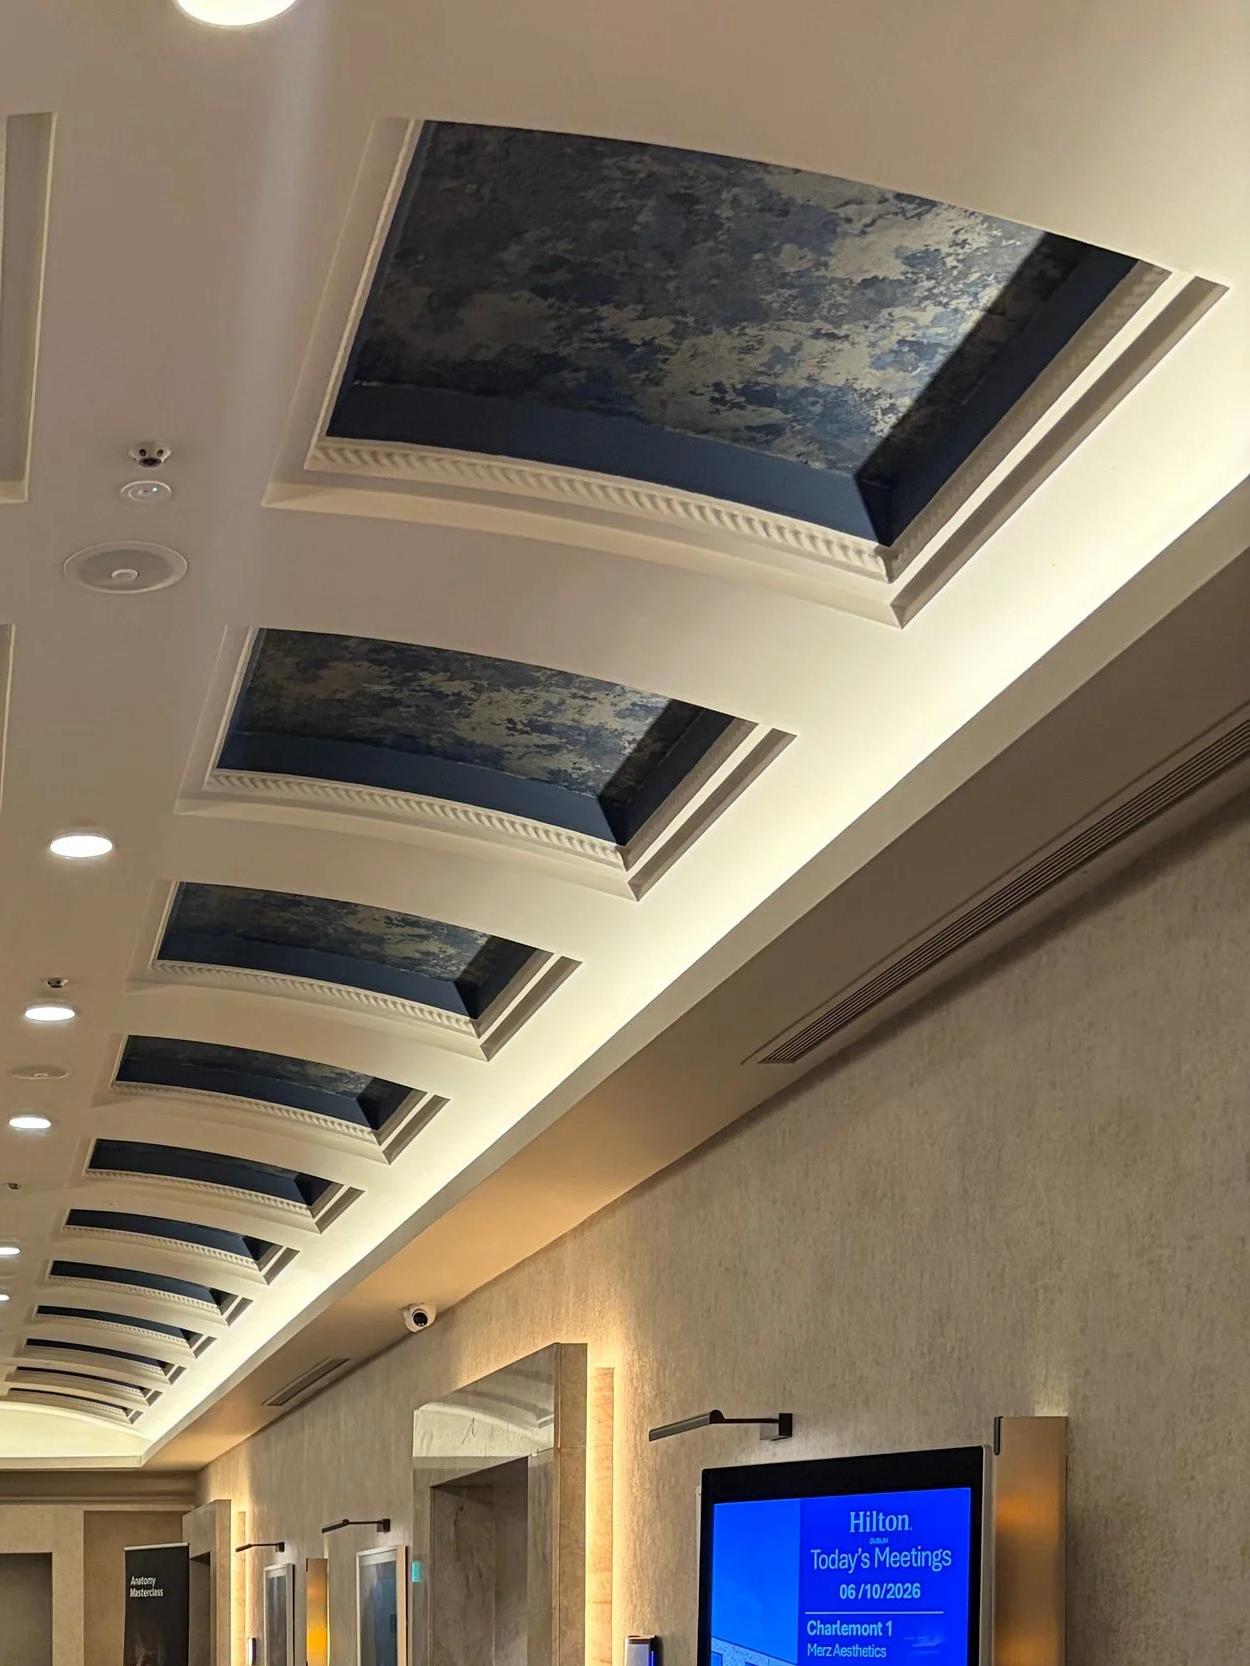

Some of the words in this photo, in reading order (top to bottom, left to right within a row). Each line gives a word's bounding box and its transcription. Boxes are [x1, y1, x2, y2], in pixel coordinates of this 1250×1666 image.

[850, 1511, 909, 1533] Hilton
[810, 1548, 870, 1574] Today’s
[874, 1546, 952, 1572] Meetings
[130, 1576, 156, 1587] Anatomy
[130, 1587, 164, 1598] Masterclass
[807, 1620, 883, 1636] Charlemont
[886, 1620, 892, 1636] 1
[807, 1643, 832, 1657] Merz
[833, 1643, 887, 1658] Aesthetics
